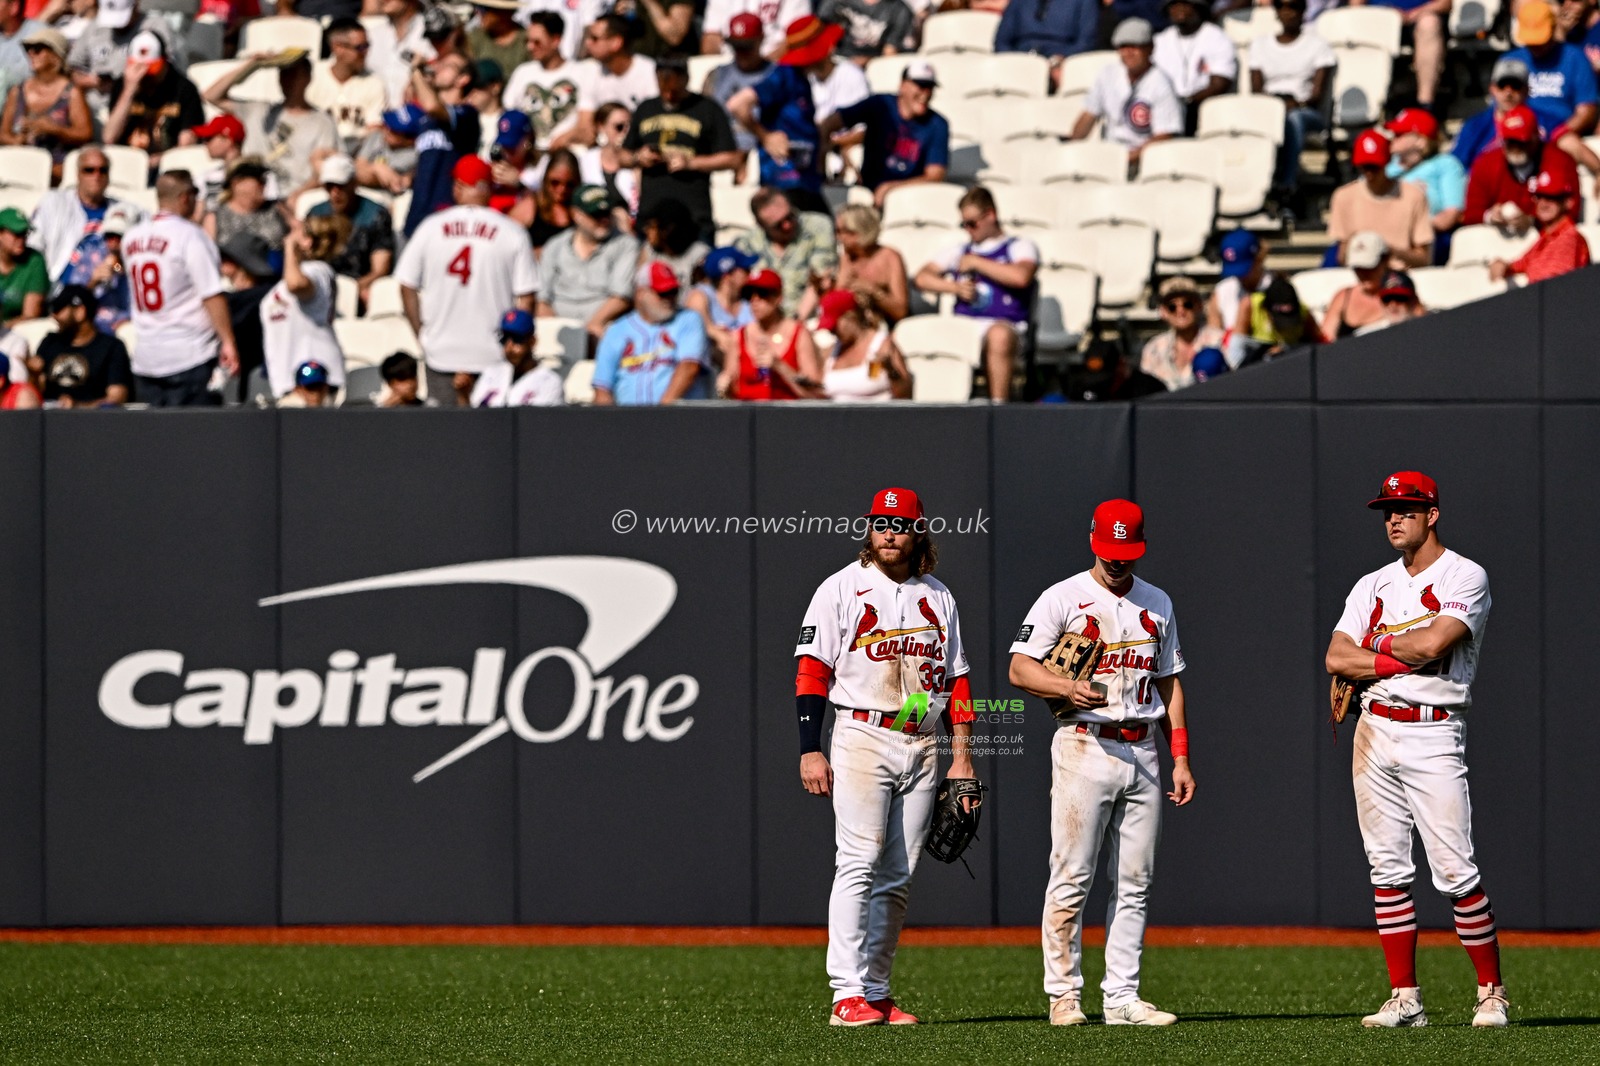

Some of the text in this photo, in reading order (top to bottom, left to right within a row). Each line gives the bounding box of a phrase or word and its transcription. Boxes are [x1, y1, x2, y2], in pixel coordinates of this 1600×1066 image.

[447, 245, 471, 286] 4
[131, 262, 163, 313] 18
[1442, 601, 1469, 614] STIFEL
[865, 628, 945, 662] Cardinals
[918, 661, 947, 695] 33
